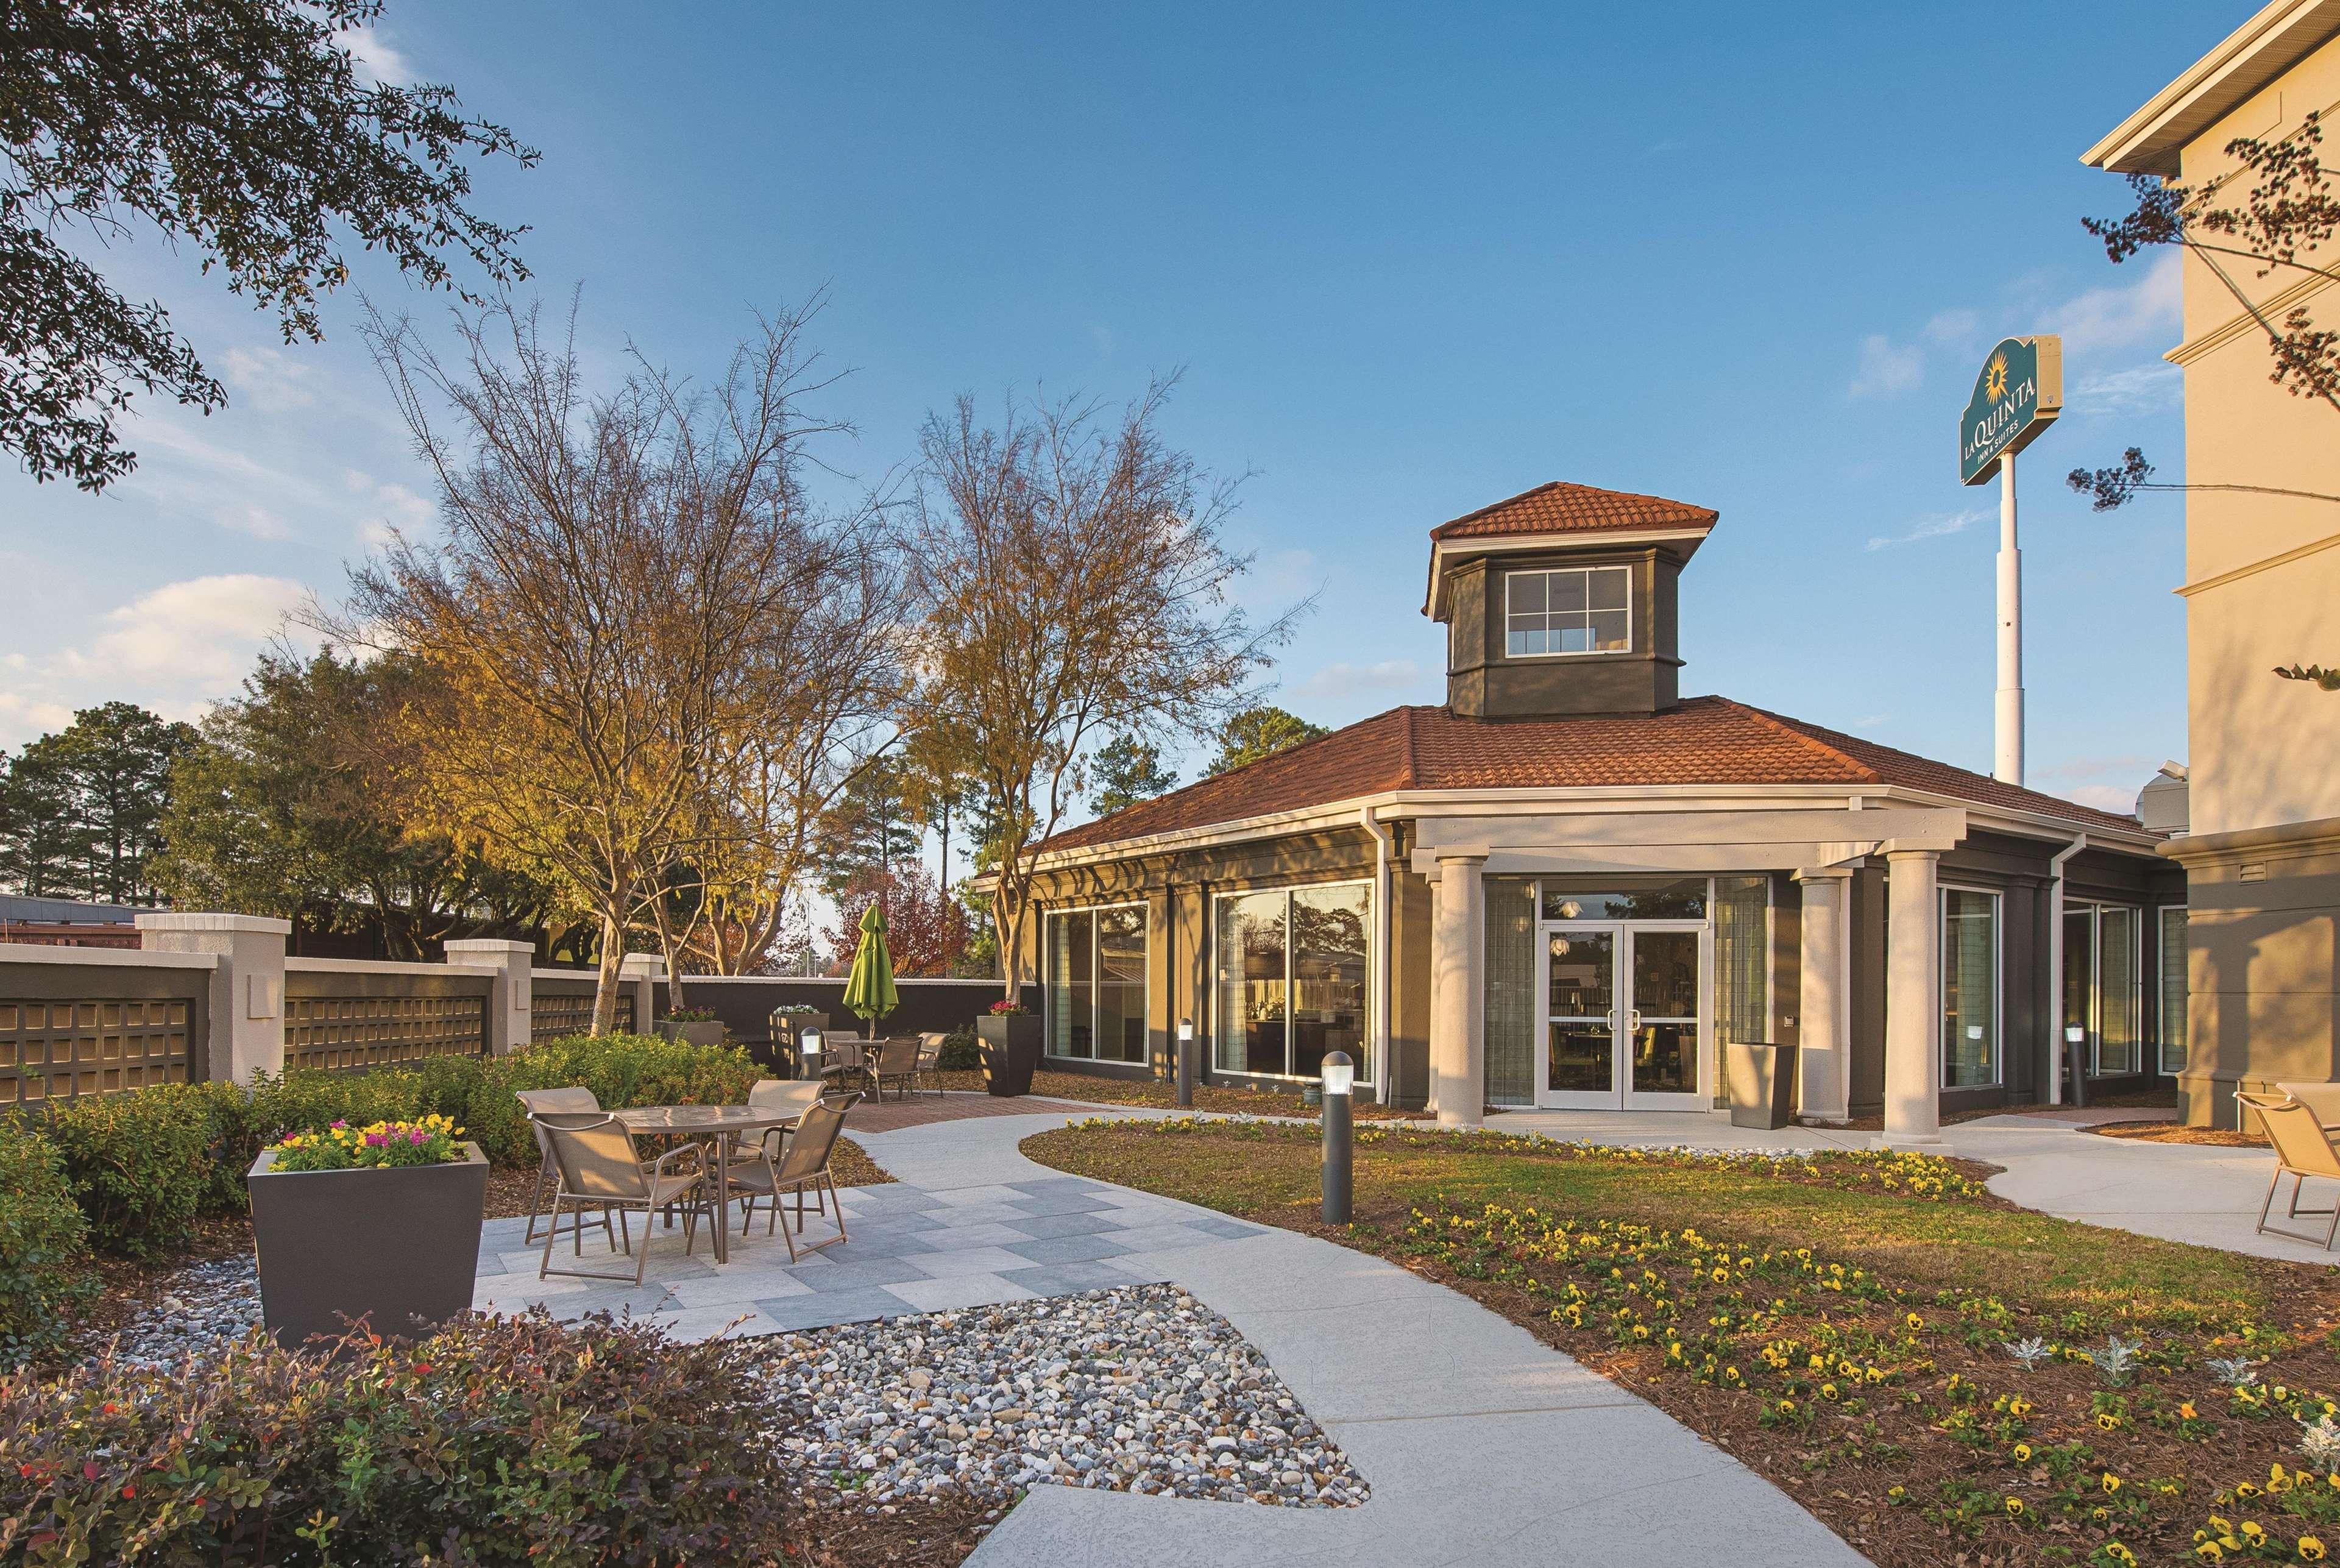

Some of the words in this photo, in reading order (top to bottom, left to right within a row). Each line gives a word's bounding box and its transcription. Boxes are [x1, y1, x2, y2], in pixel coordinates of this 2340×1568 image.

[1965, 442, 1974, 461] LA
[1974, 377, 2035, 447] QUINTA
[1977, 448, 1988, 464] INN
[1994, 419, 2019, 448] SUITES
